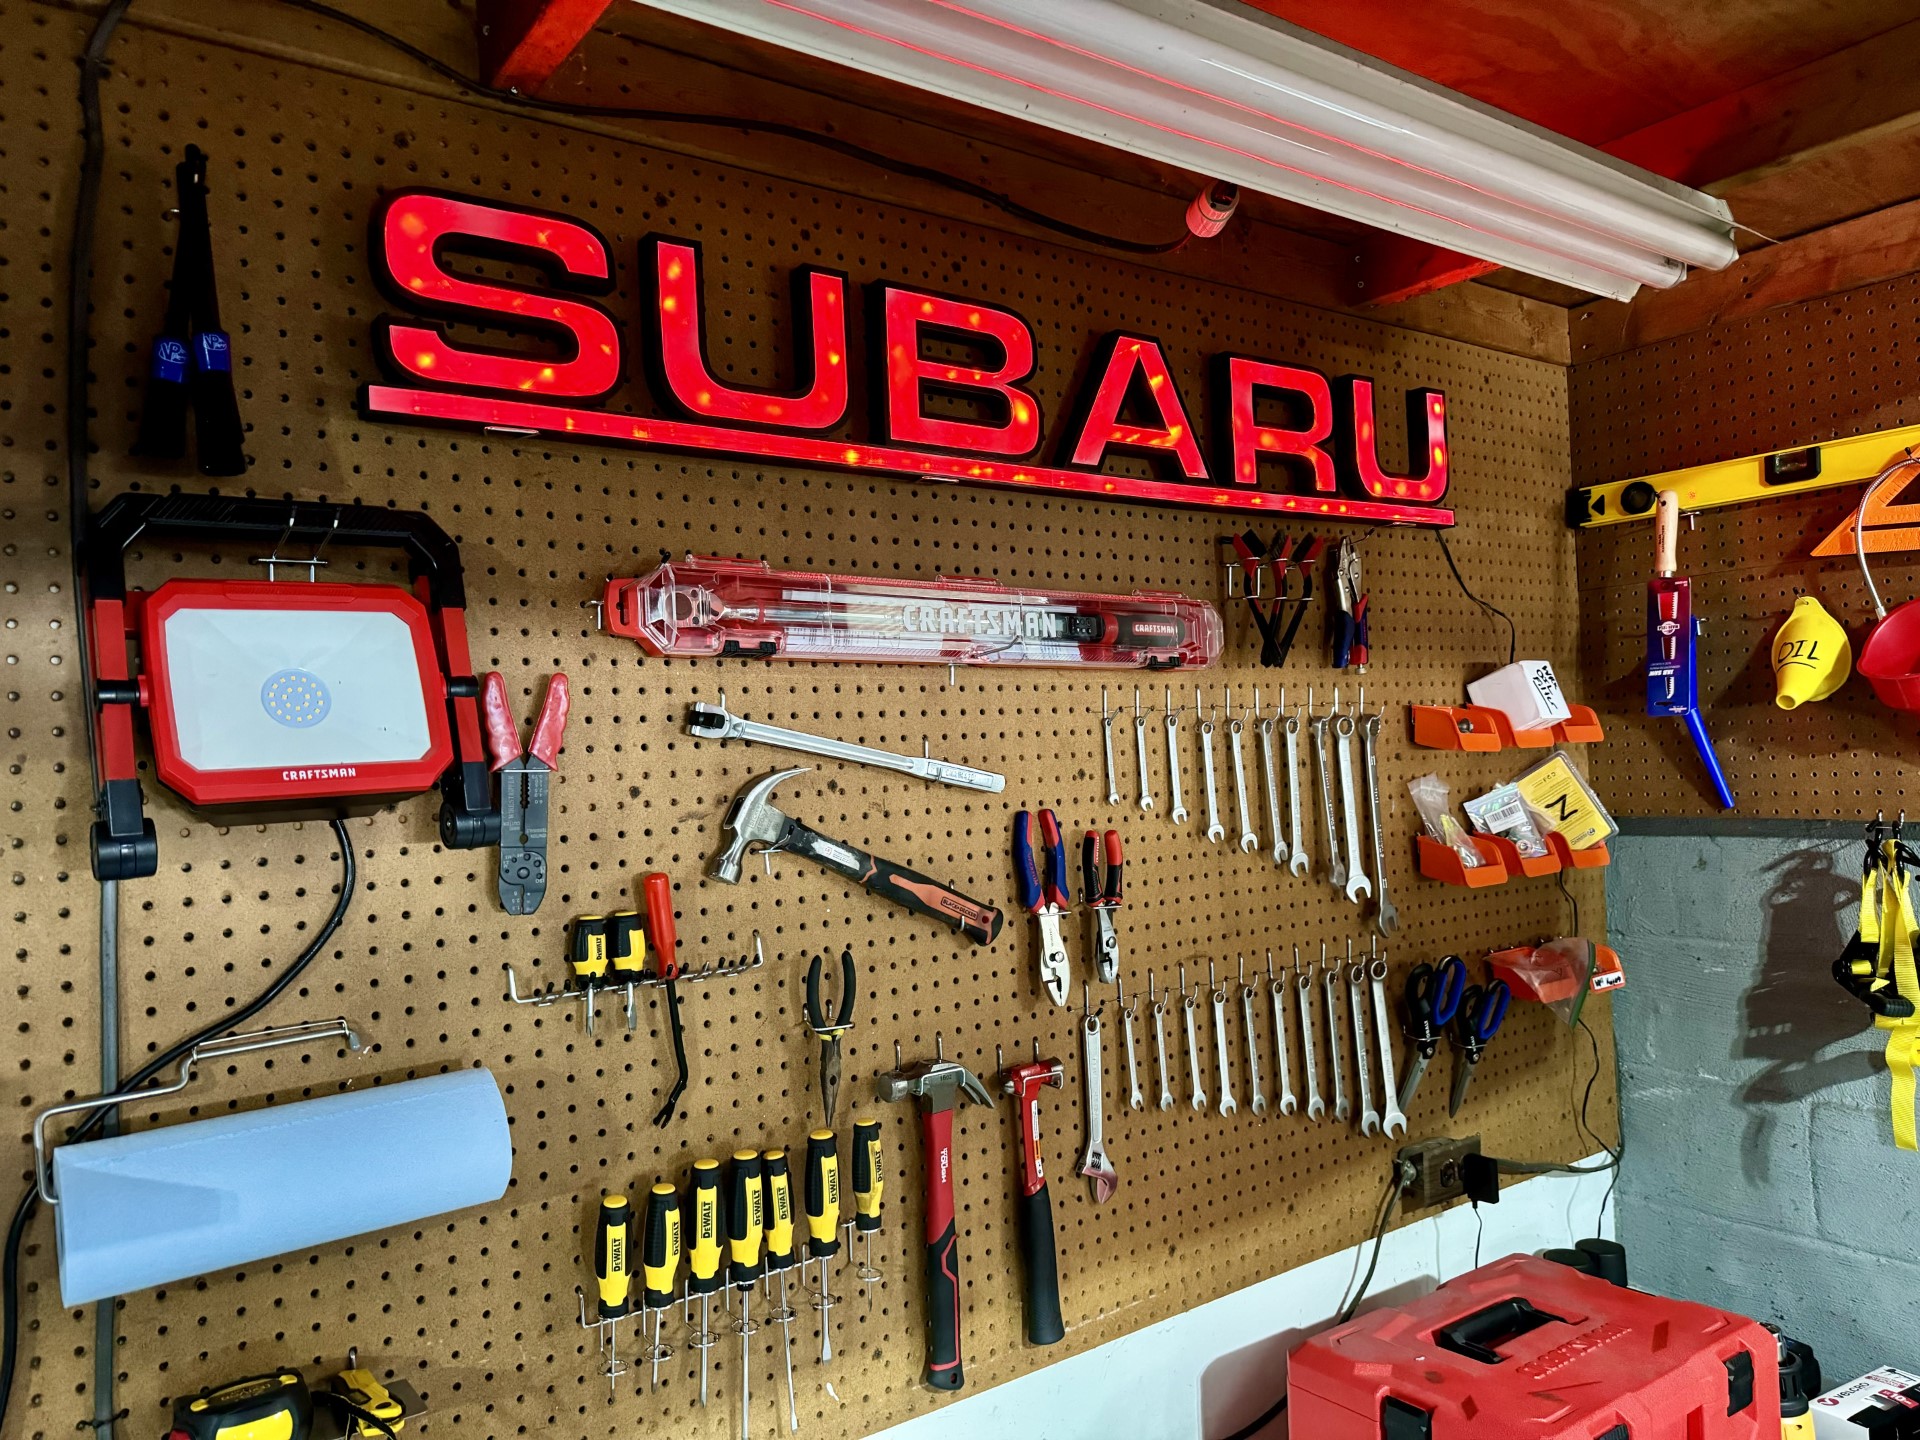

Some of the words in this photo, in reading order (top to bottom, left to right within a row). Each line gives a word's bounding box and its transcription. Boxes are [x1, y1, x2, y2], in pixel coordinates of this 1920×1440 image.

[381, 193, 1450, 504] SUBARU
[903, 605, 1057, 638] CRAFTSMAN
[1135, 624, 1178, 634] CRAFTSMAN
[1777, 639, 1820, 664] OIL
[282, 767, 356, 781] CRAFTSMAN
